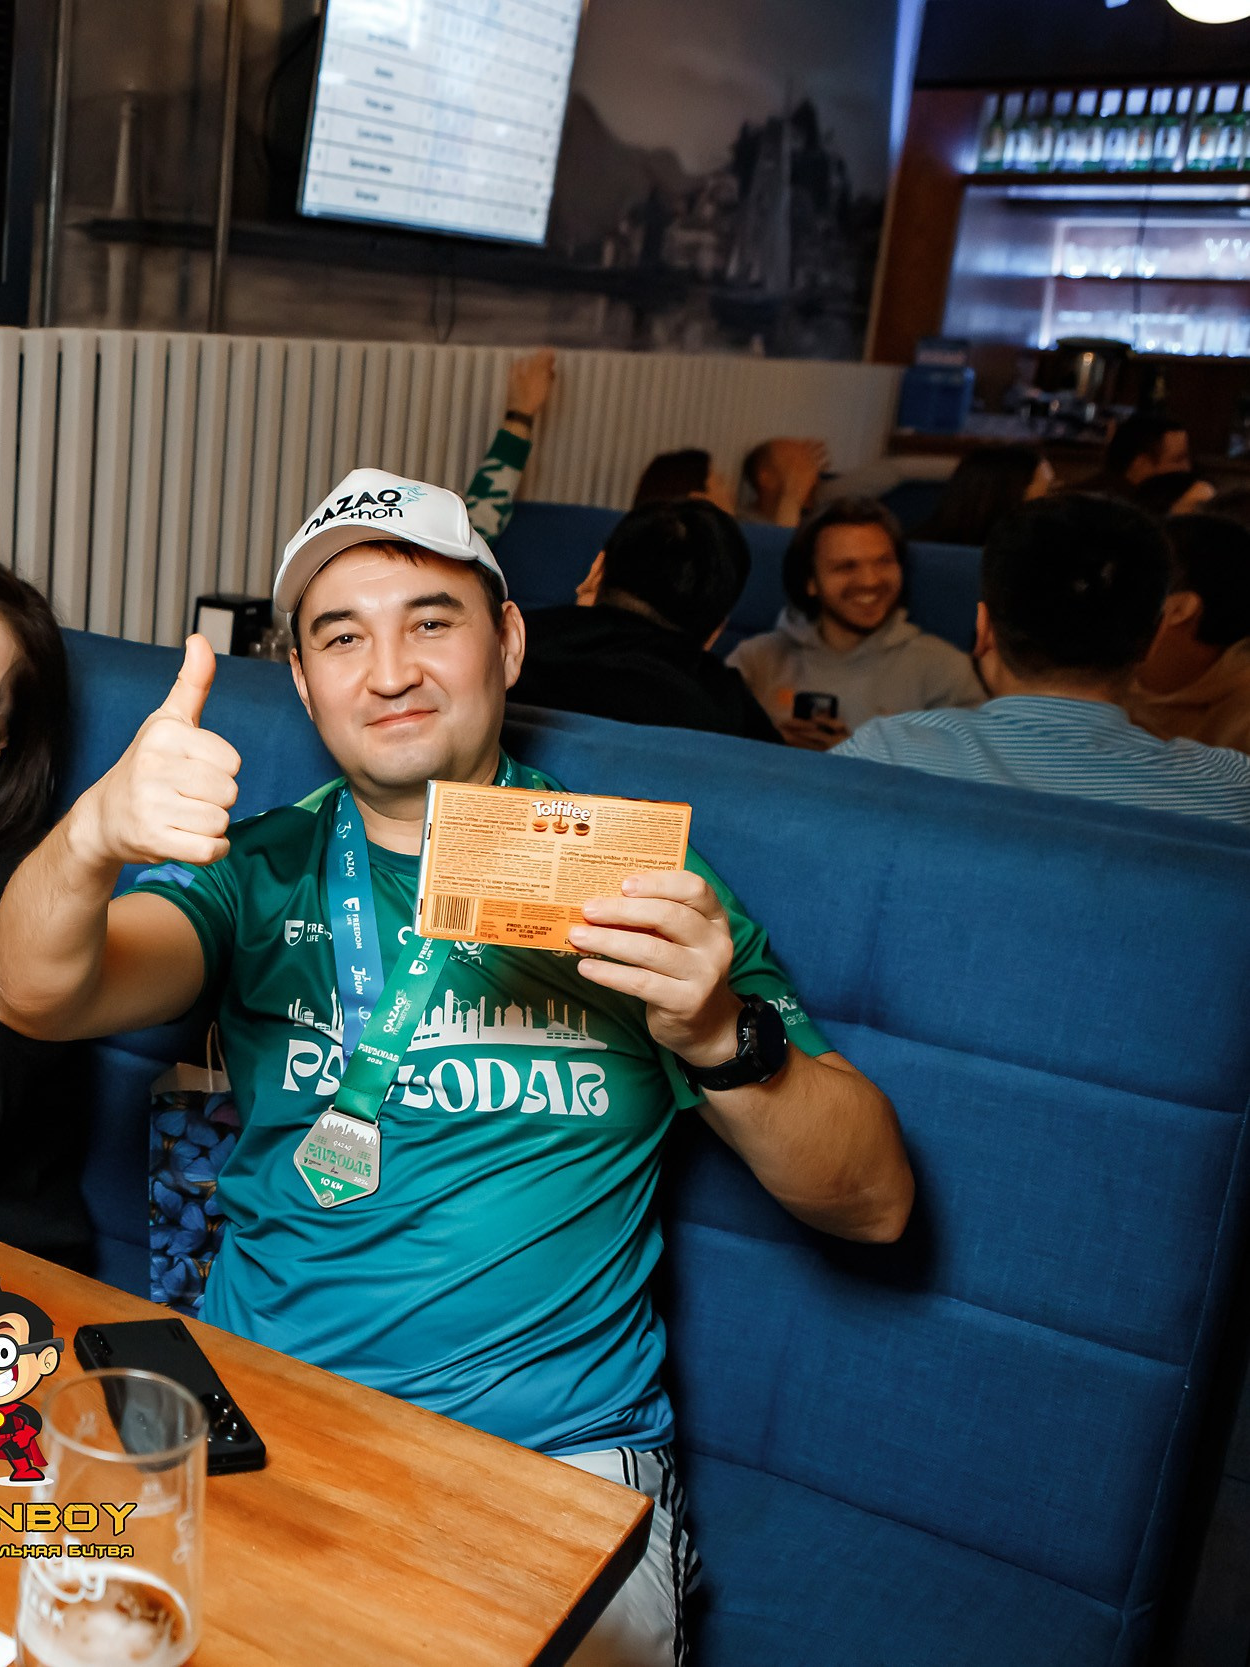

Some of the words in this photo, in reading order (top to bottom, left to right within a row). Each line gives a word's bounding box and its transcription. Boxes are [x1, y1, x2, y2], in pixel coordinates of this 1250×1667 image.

[531, 800, 592, 821] Toffifee
[344, 850, 356, 877] QAZAQ
[306, 934, 319, 942] LIFE
[352, 913, 363, 950] FREEDOM
[383, 997, 406, 1033] QAZAQ
[366, 1056, 383, 1066] 2024
[333, 1140, 352, 1152] QAZAQ
[320, 1177, 330, 1187] 10
[330, 1181, 344, 1191] KM
[353, 1176, 369, 1186] 2024
